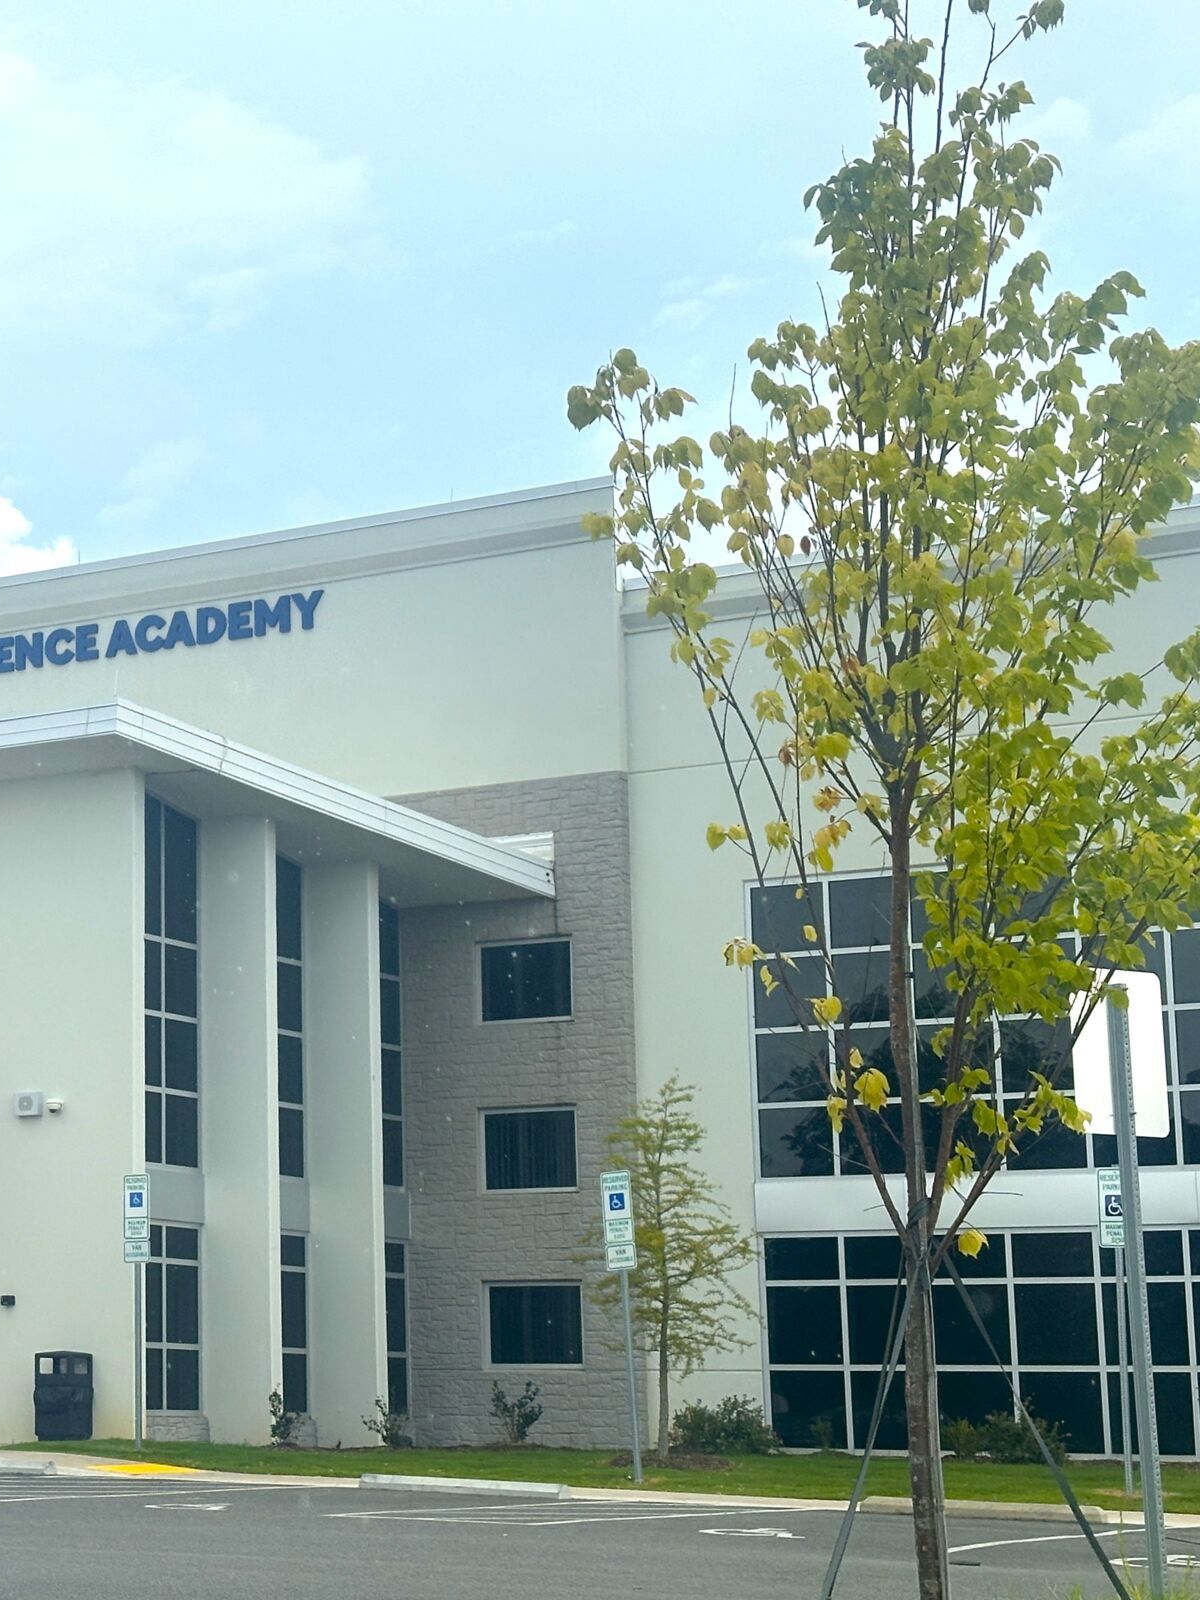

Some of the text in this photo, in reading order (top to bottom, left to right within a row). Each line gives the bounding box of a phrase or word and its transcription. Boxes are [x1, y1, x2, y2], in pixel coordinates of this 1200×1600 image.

[105, 589, 324, 658] ACADEMY
[604, 1183, 628, 1192] PARKING
[615, 1248, 626, 1256] VAN
